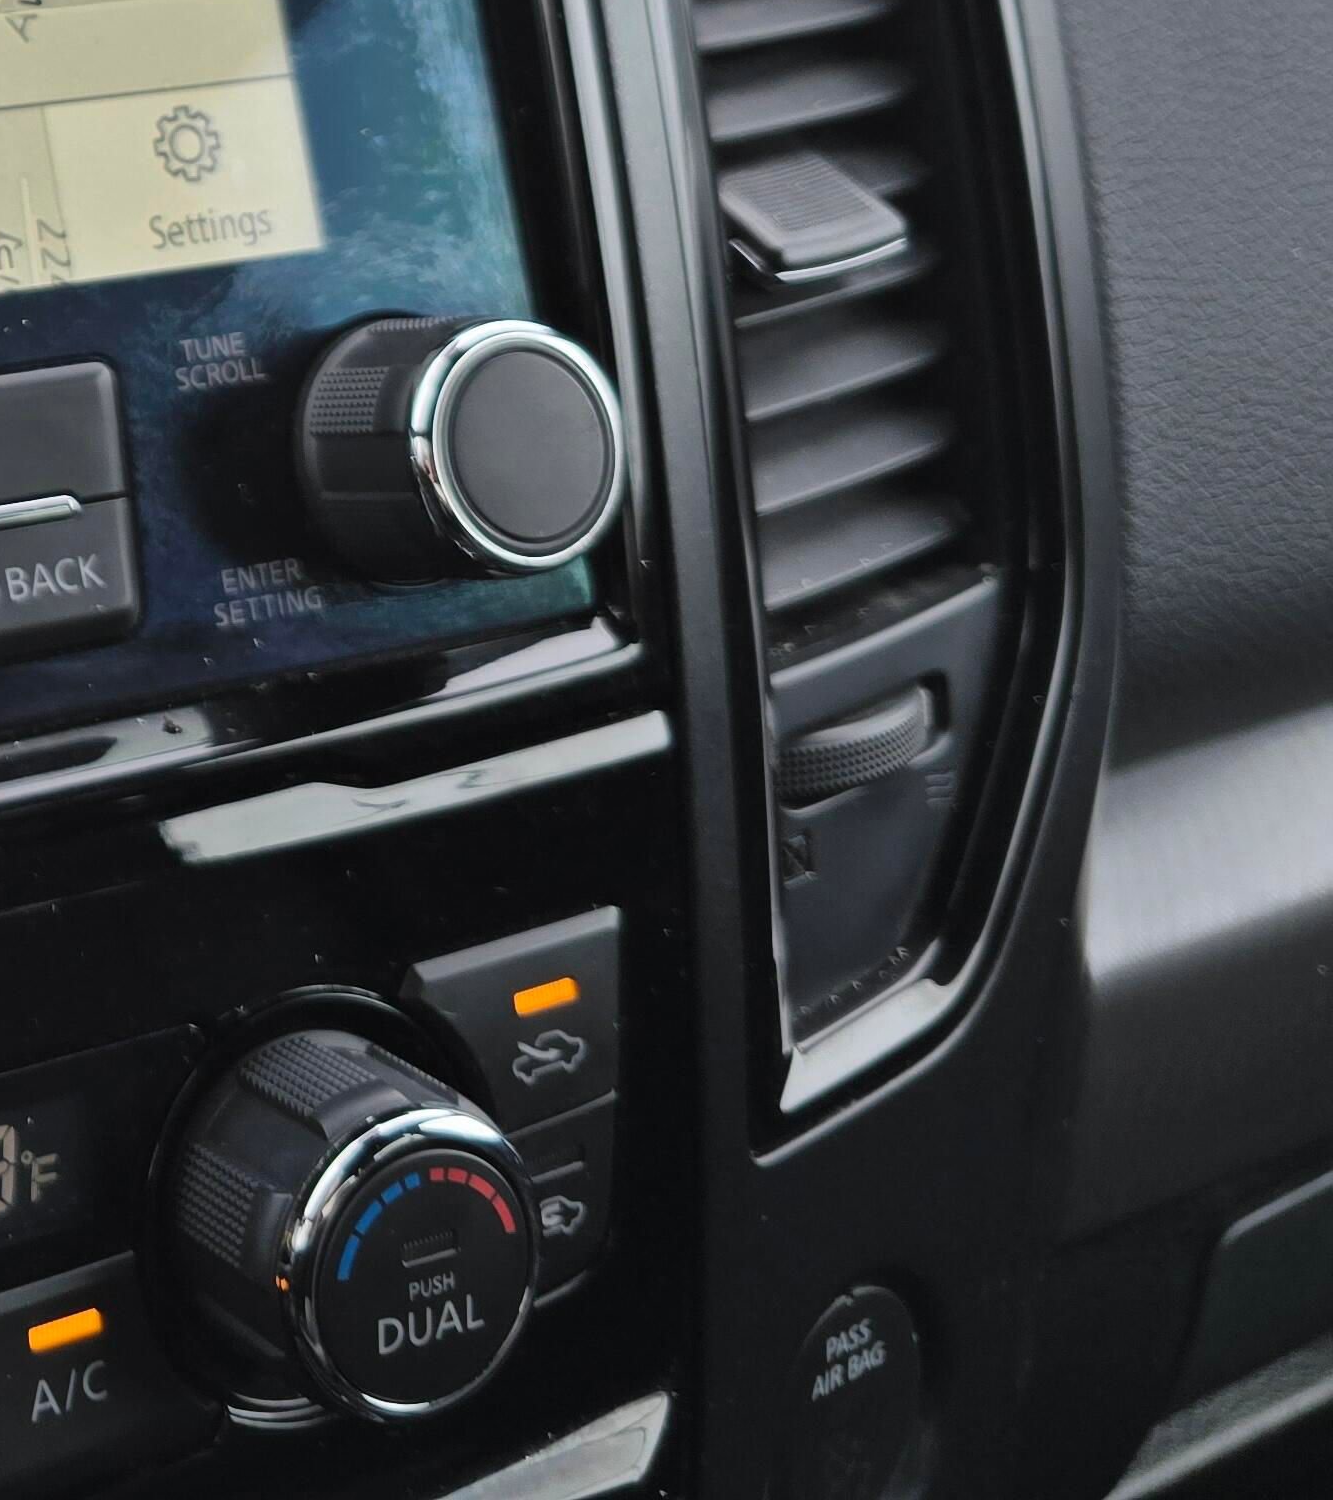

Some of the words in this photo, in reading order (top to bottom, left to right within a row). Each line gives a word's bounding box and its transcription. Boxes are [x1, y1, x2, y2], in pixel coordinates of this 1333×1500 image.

[149, 206, 272, 250] Settings
[180, 332, 244, 361] TUNE
[174, 358, 269, 391] SCROLL
[6, 554, 106, 599] BACK
[221, 558, 301, 597] ENTER
[212, 583, 323, 628] SETTING
[407, 1270, 455, 1300] PUSH
[377, 1298, 485, 1355] DUAL
[826, 1318, 872, 1363] PASS
[30, 1361, 106, 1422] A/C
[812, 1364, 845, 1402] AIR
[848, 1340, 886, 1381] BAG
